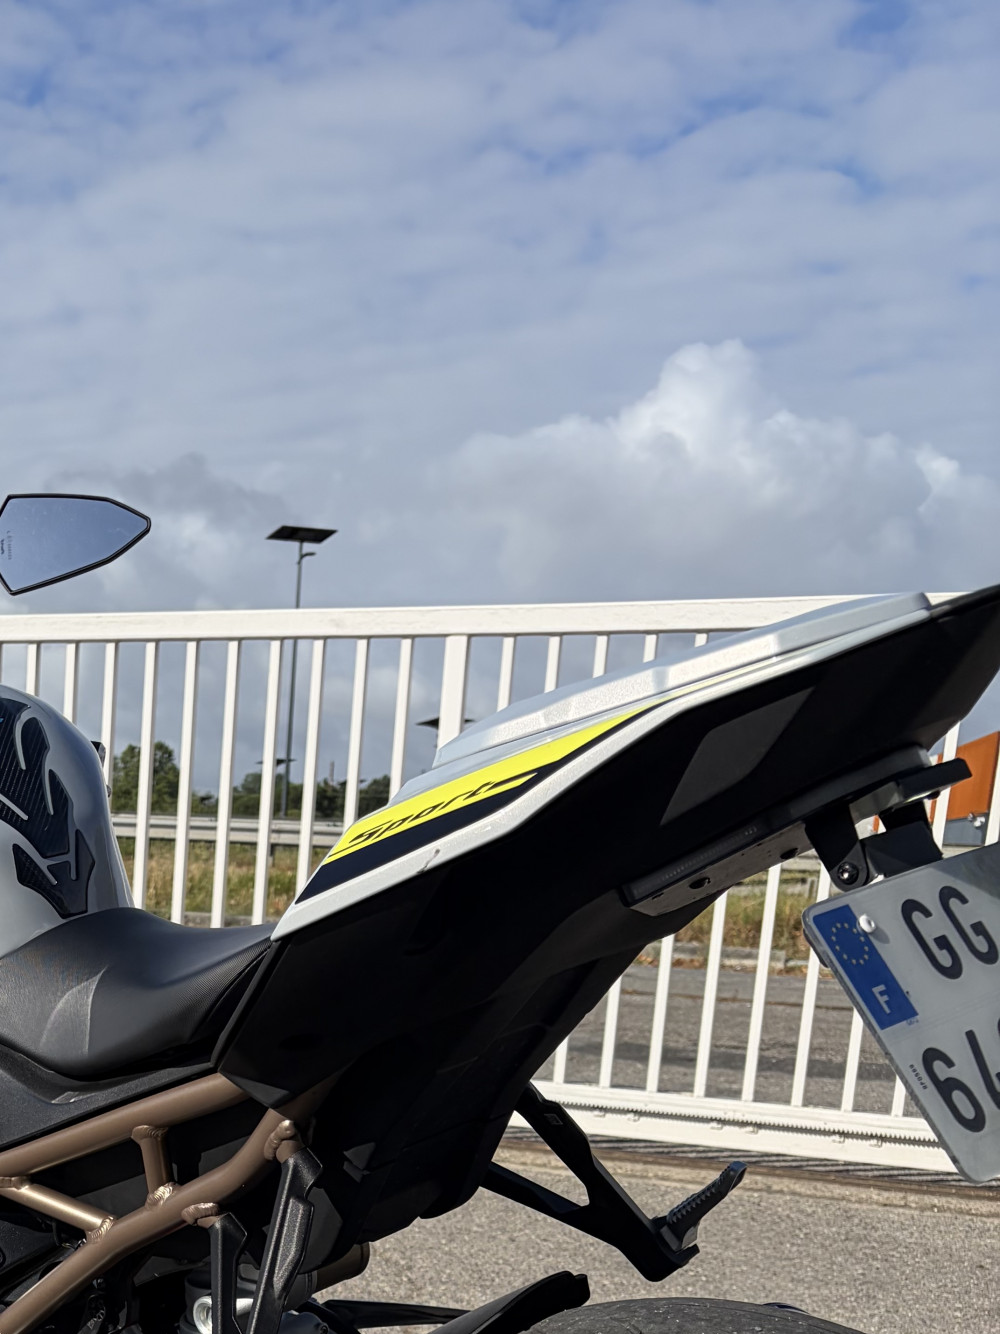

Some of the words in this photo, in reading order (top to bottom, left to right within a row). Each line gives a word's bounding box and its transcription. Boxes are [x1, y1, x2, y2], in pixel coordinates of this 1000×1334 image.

[330, 778, 515, 857] Sport
[901, 886, 999, 979] GG
[872, 984, 891, 1015] F
